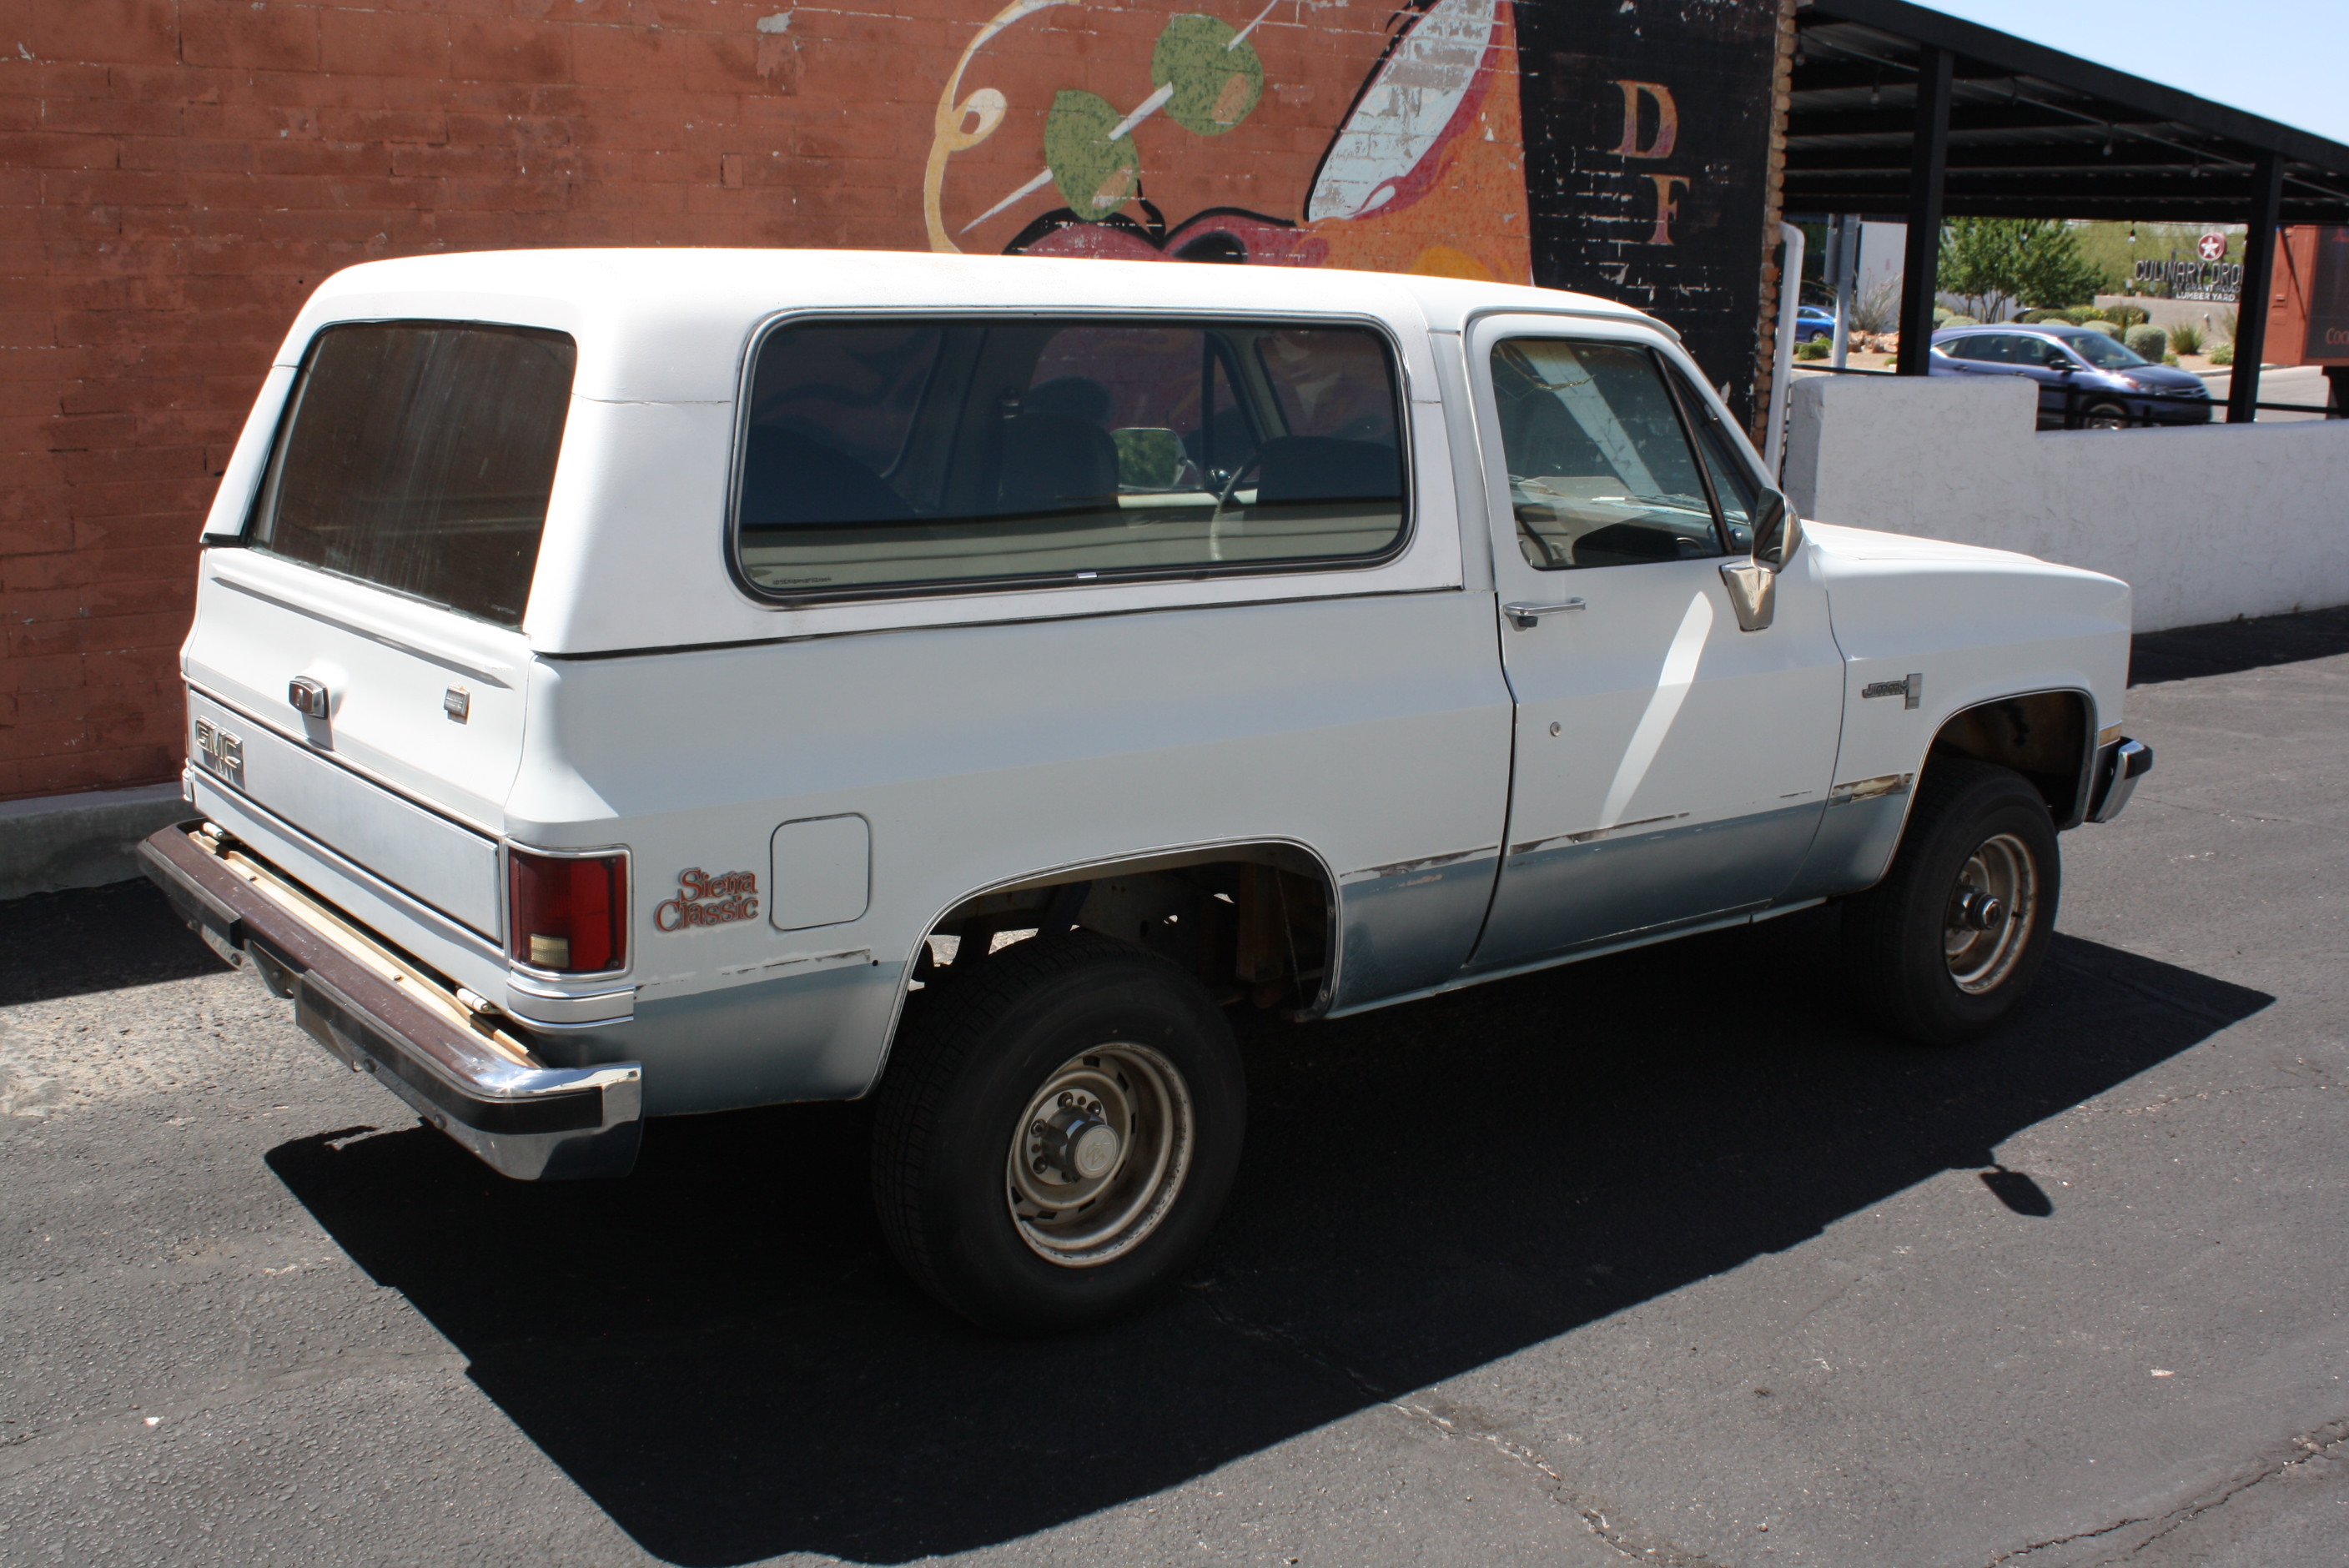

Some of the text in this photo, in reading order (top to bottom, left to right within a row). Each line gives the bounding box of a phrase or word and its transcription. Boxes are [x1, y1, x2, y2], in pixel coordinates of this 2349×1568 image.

[1607, 79, 1678, 158] D
[1646, 173, 1691, 245] F
[2135, 260, 2244, 285] CULINARY DRO
[2175, 291, 2236, 302] LUMBER YARD
[195, 716, 242, 769] GMC
[678, 867, 758, 902] Sierra
[653, 896, 760, 932] Classic
